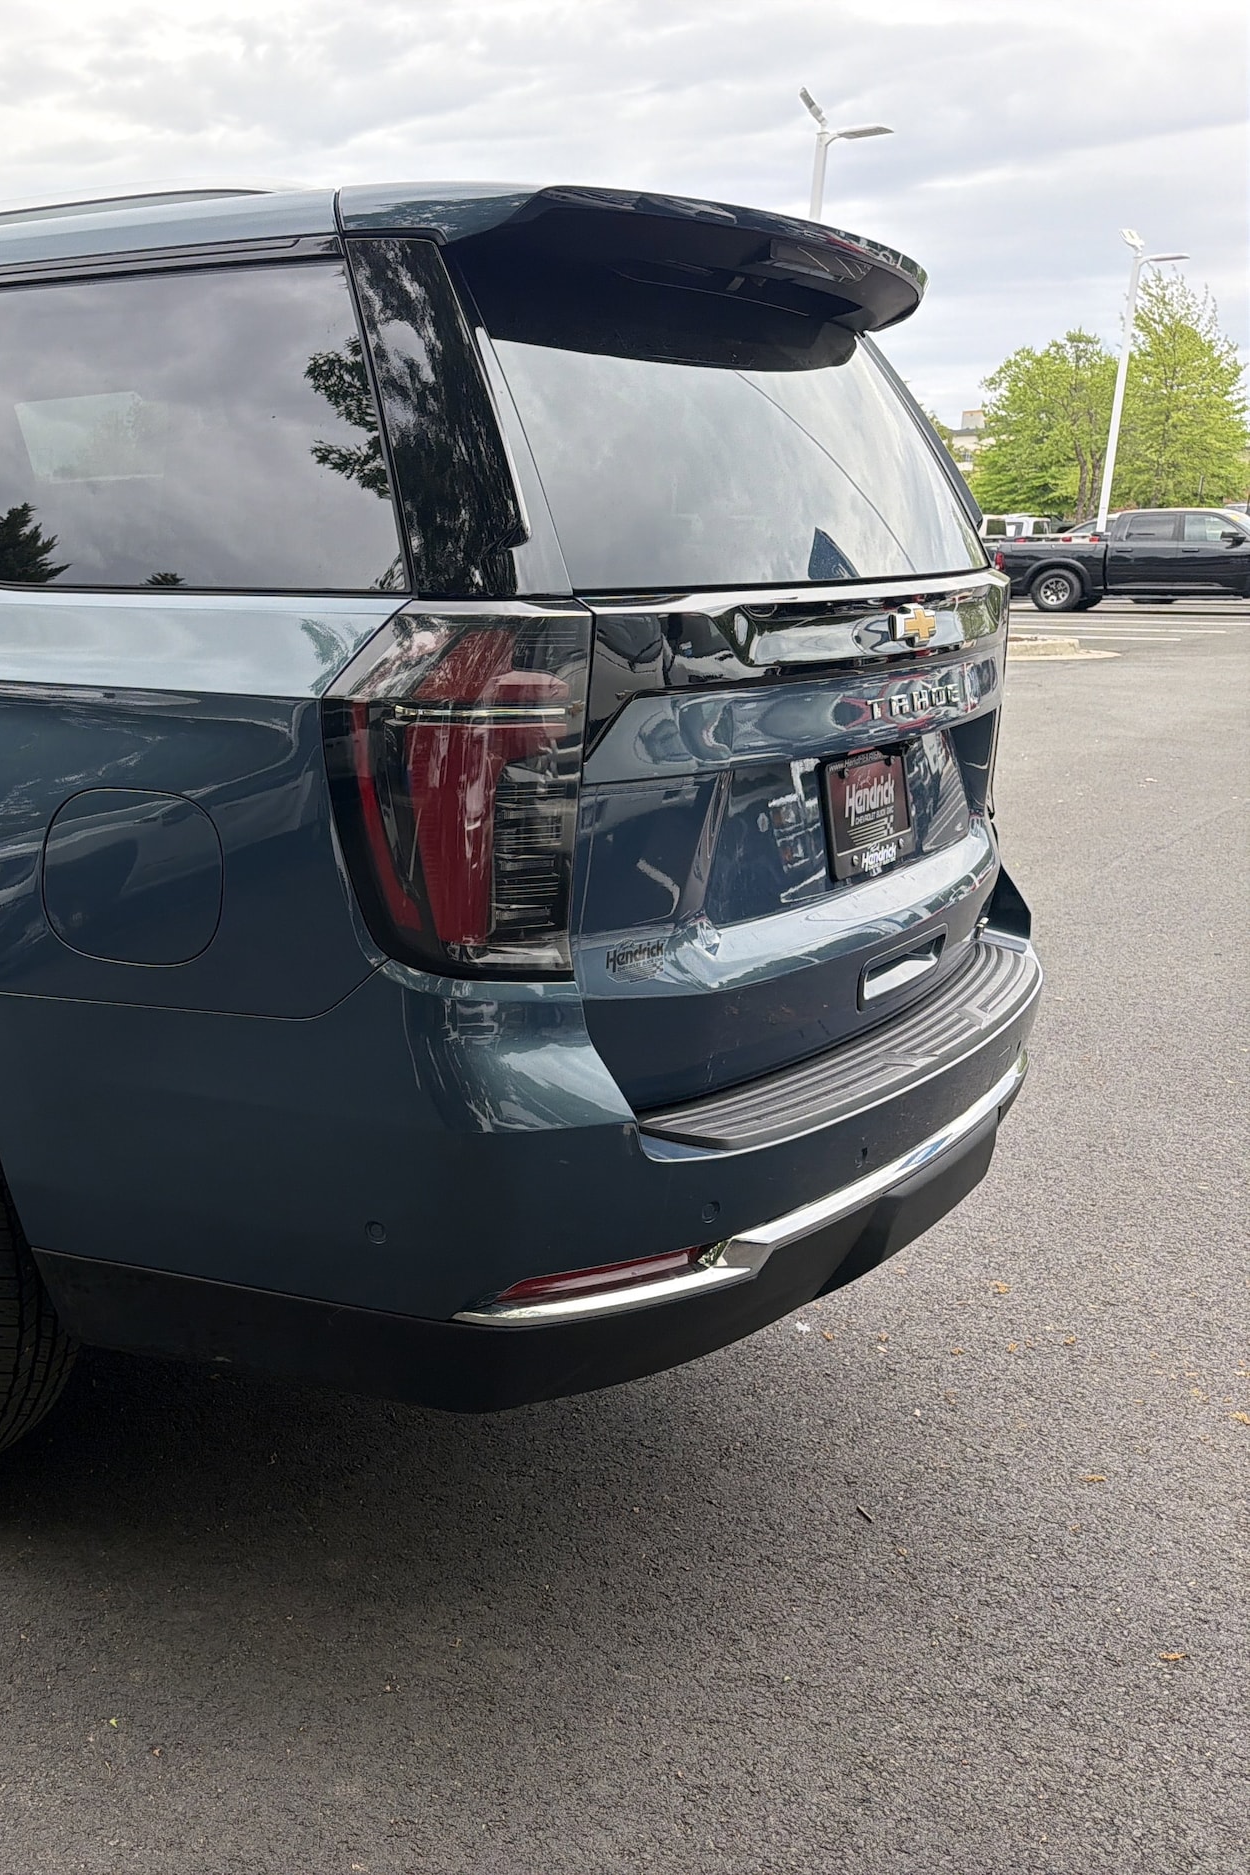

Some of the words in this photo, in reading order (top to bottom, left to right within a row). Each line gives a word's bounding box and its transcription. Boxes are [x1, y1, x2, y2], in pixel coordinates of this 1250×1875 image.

[866, 683, 960, 720] TAHOE
[845, 773, 895, 827] Hendrick
[861, 842, 897, 872] Hendrick
[606, 939, 665, 973] Hendrick
